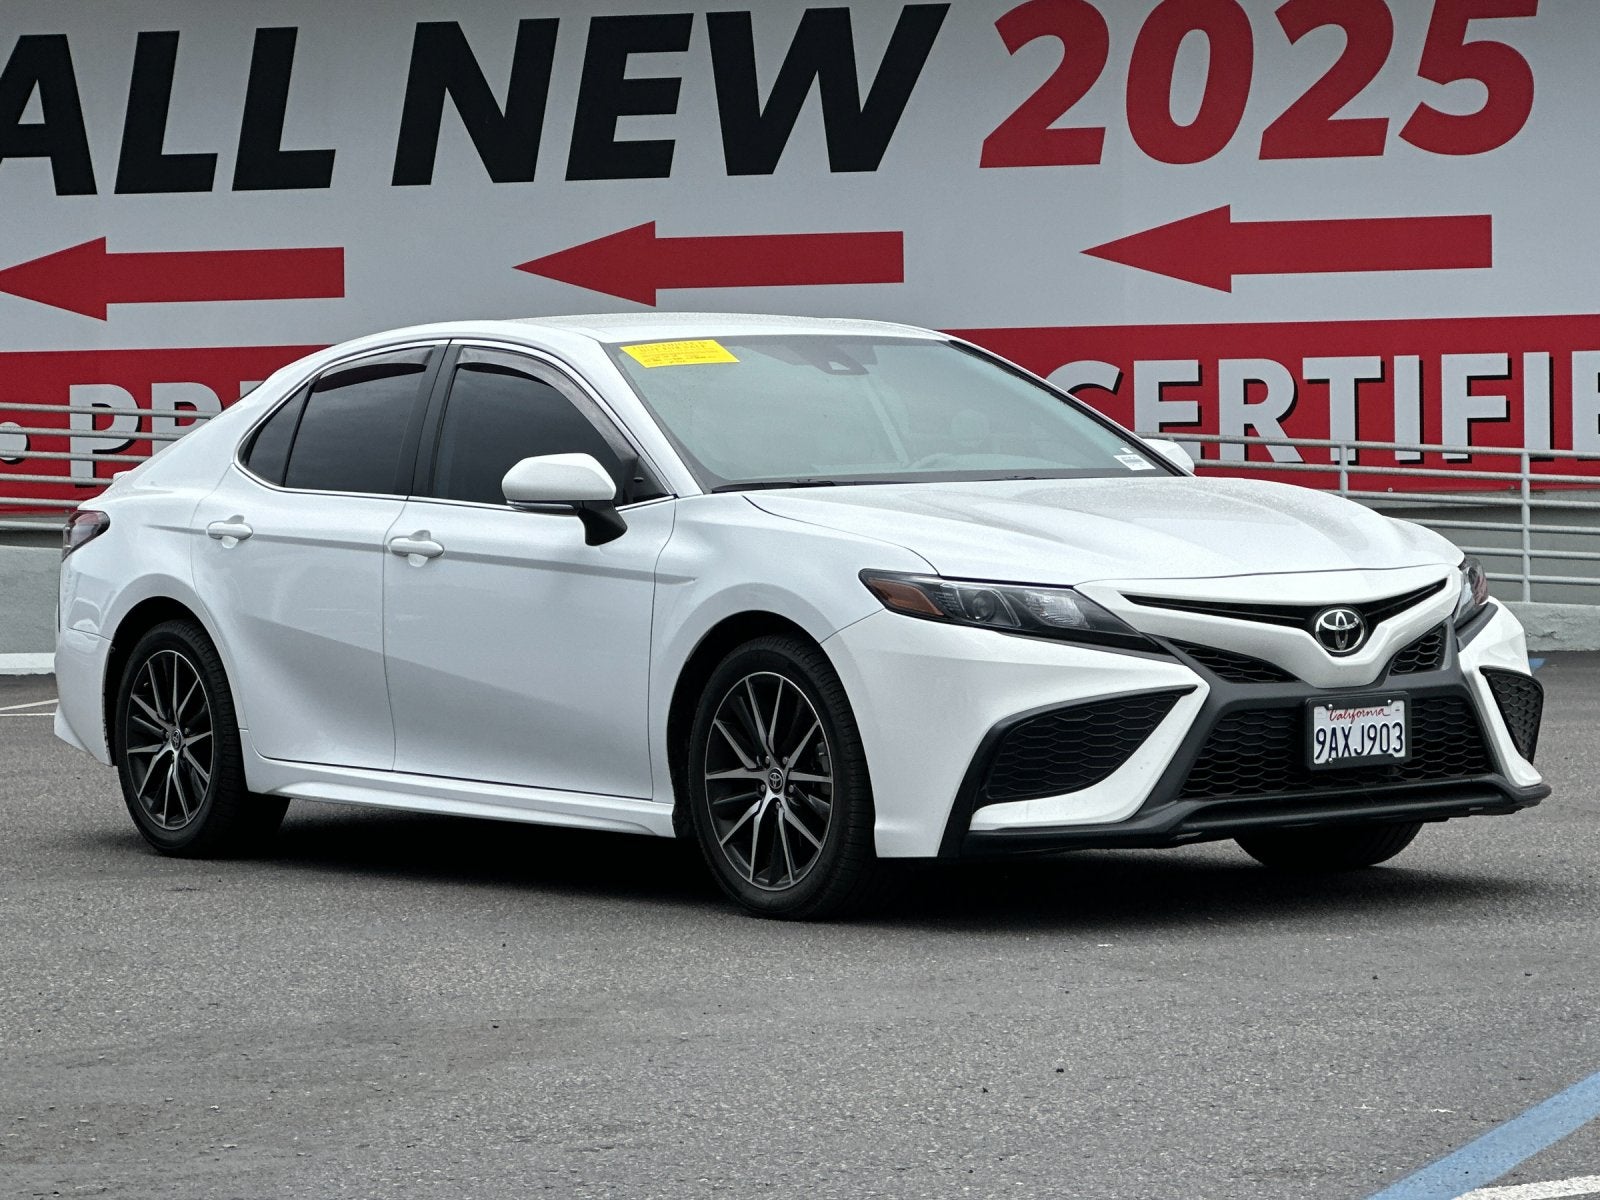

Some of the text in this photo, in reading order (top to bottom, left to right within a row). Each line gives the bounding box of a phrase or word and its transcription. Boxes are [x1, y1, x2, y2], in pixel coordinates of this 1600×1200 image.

[0, 0, 1538, 196] ALL NEW 2025
[1328, 707, 1391, 725] California
[1315, 721, 1403, 760] 9AXJ903
